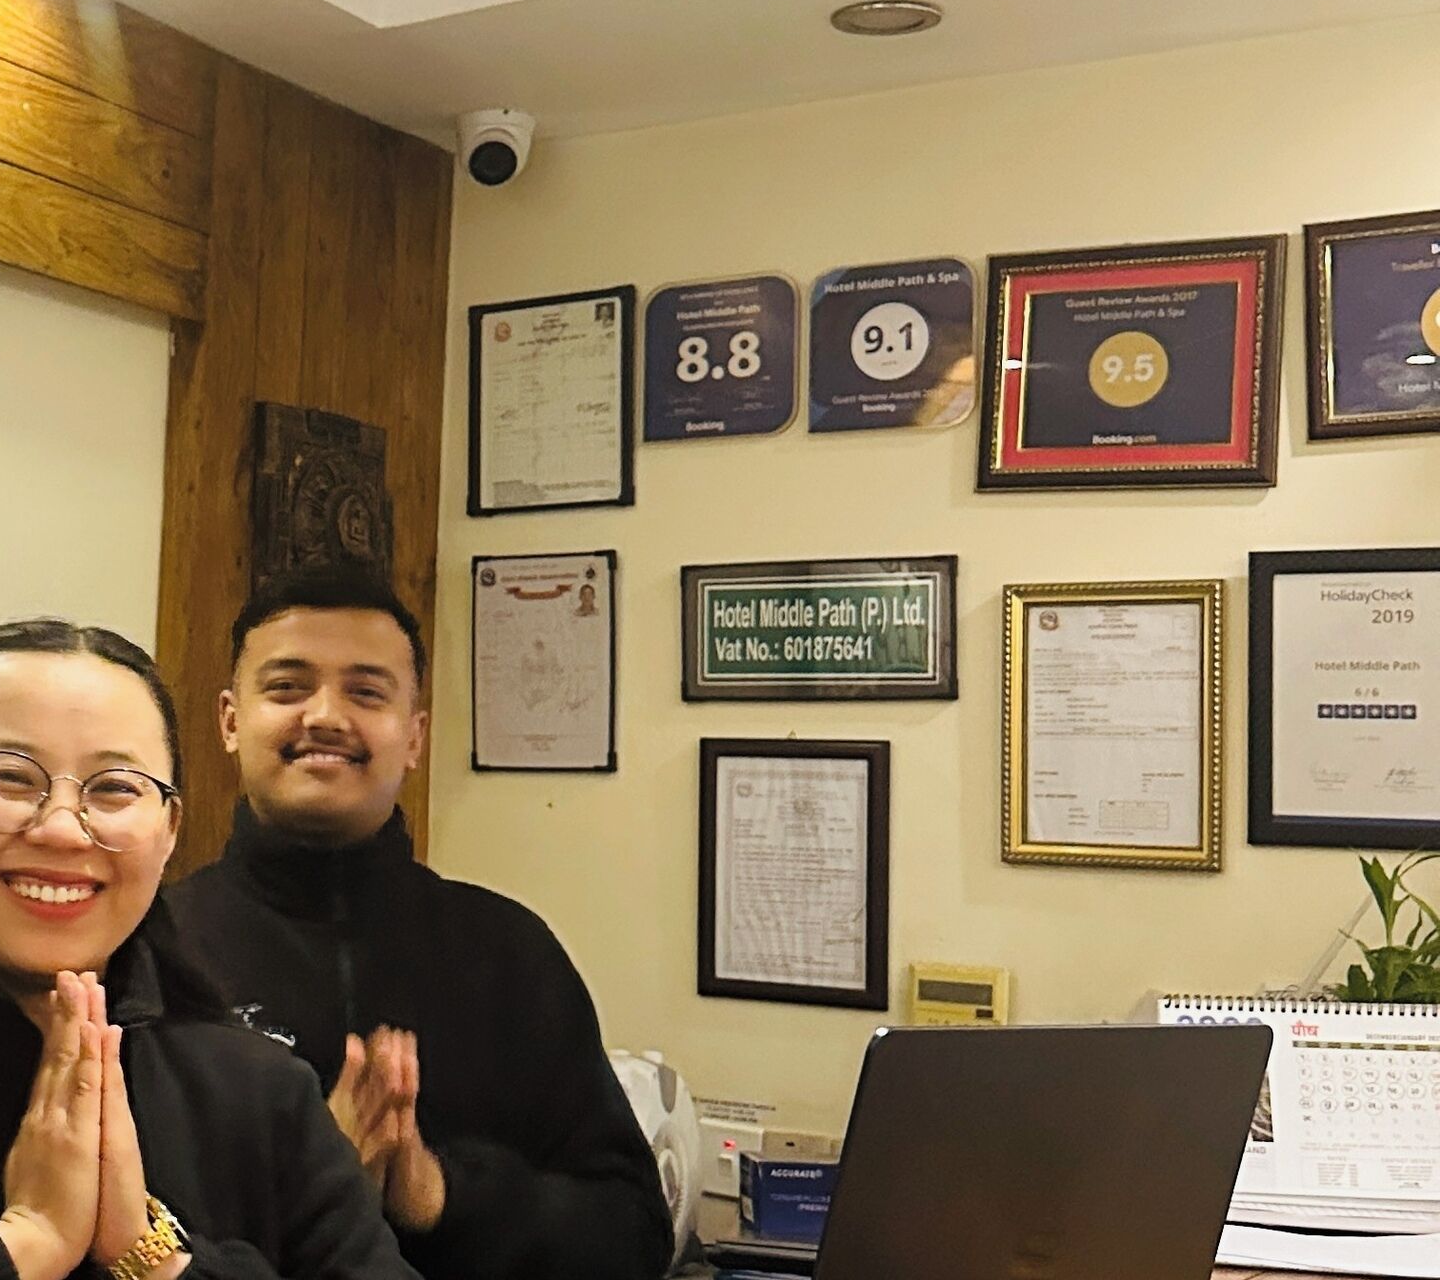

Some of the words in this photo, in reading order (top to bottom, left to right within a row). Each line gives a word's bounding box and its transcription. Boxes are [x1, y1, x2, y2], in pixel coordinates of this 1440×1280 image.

[824, 281, 854, 293] Hotel
[857, 278, 895, 290] Middle
[898, 274, 924, 286] Path
[926, 274, 936, 284] &
[938, 272, 960, 284] Spa
[1065, 298, 1096, 308] Guest
[1098, 296, 1132, 307] Review
[1134, 294, 1170, 304] Awards
[676, 310, 702, 320] Hotel
[704, 306, 738, 318] Middle
[738, 304, 760, 314] Path
[863, 322, 913, 355] 9.1
[676, 331, 761, 382] 8.8
[1102, 353, 1154, 384] 9.5
[1398, 383, 1430, 394] Hotel
[1320, 588, 1414, 604] HolidayCheck
[713, 598, 756, 628] Hotel
[760, 598, 814, 628] Middle
[818, 597, 856, 627] Path
[861, 596, 888, 634] (P.)
[893, 596, 925, 626] Ltd.
[1371, 608, 1415, 624] 2019
[715, 637, 742, 661] Vat
[746, 637, 779, 661] No.:
[784, 636, 872, 660] 601875641
[1314, 661, 1346, 671] Hotel
[1350, 661, 1390, 672] Middle
[1392, 660, 1420, 671] Path
